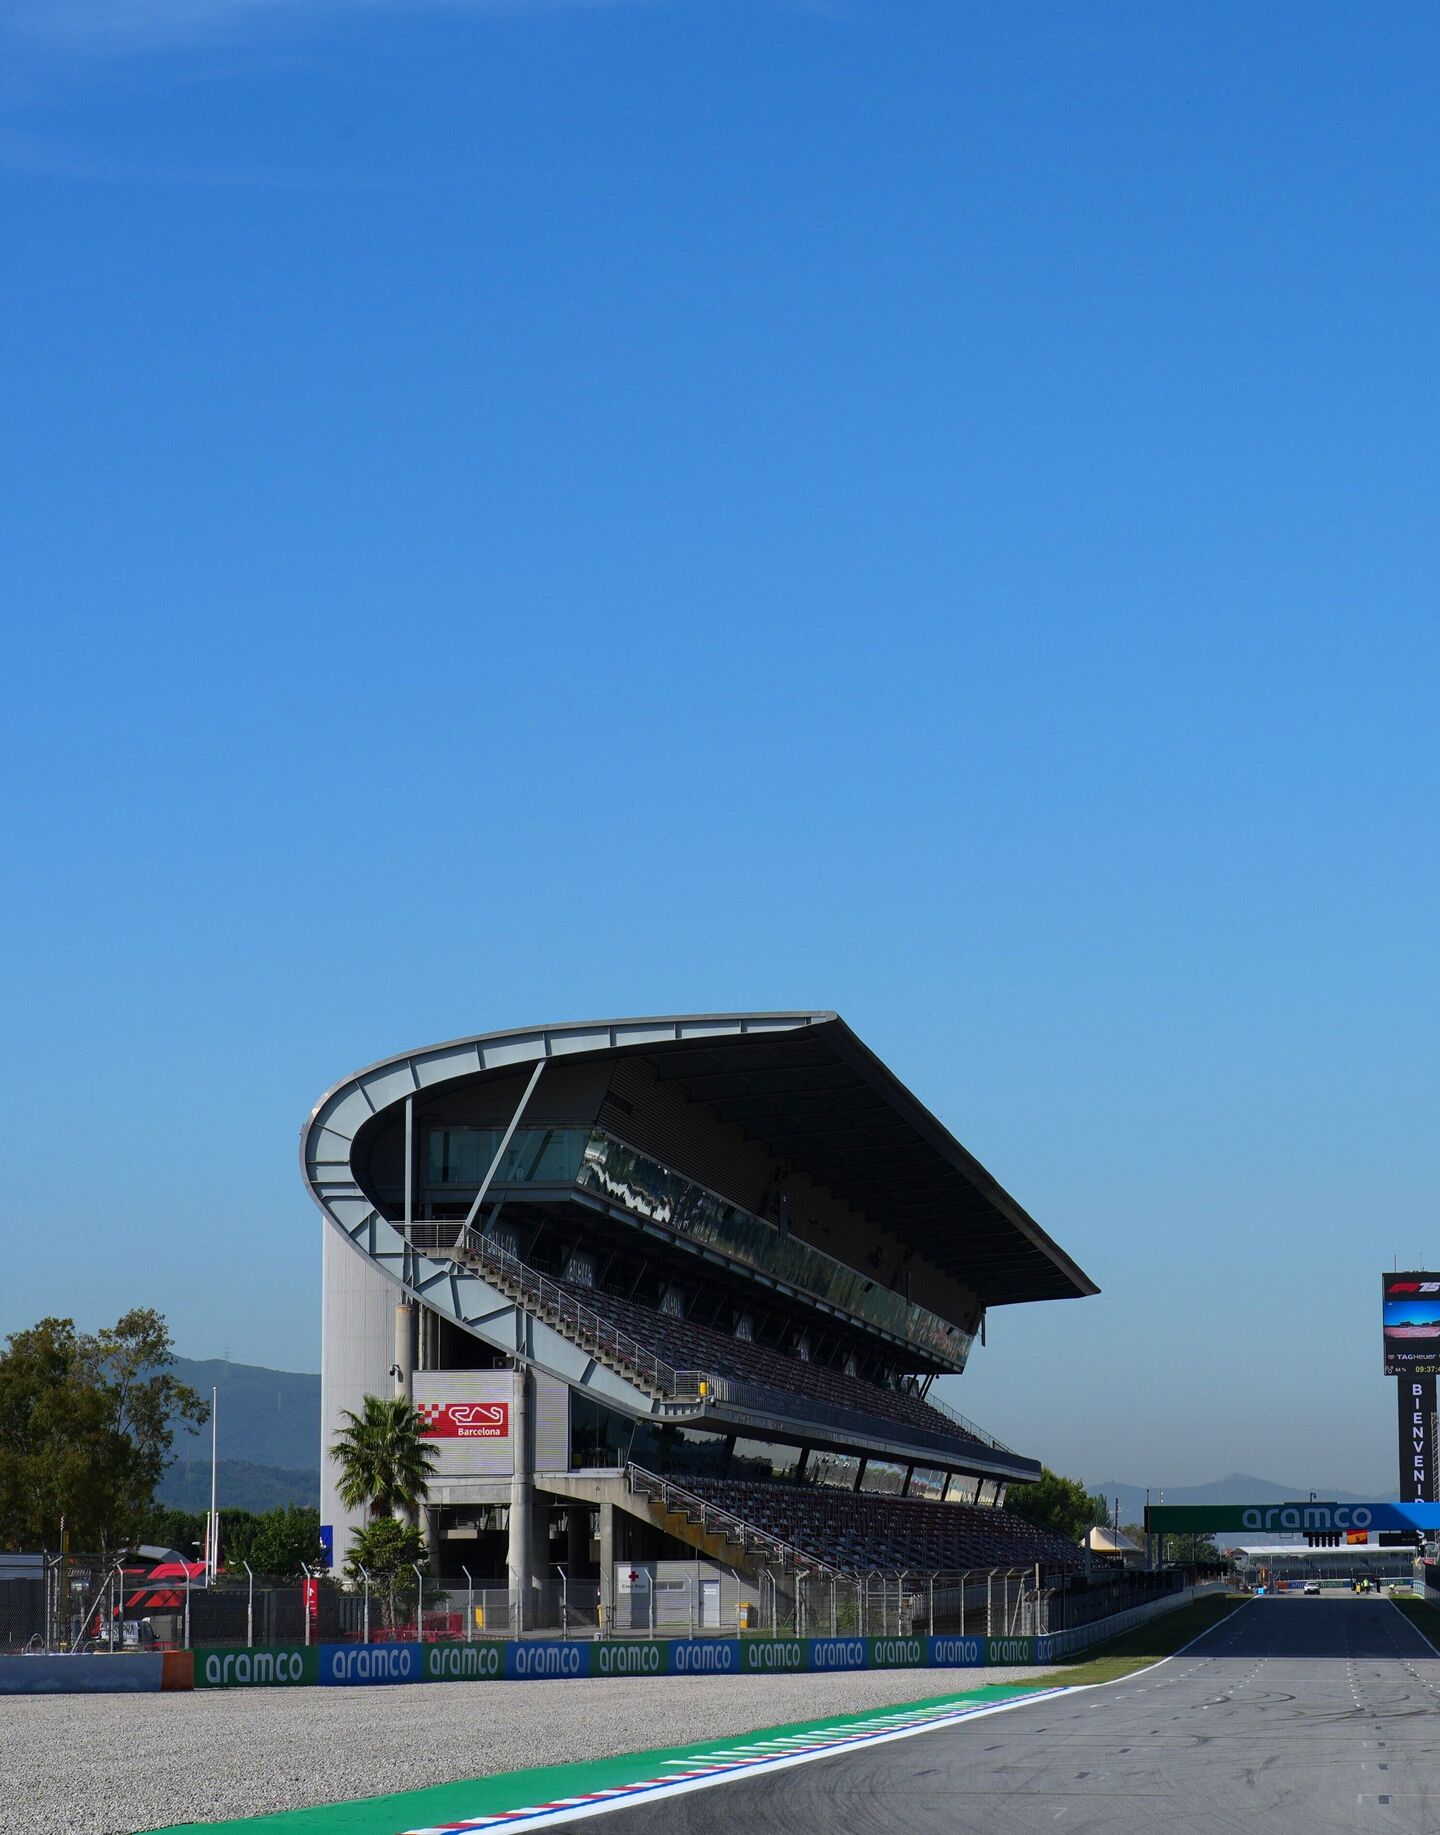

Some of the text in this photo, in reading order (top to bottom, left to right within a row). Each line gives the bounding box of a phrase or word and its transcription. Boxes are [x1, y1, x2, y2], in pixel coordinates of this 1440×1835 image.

[458, 1427, 500, 1436] Barcelona
[1242, 1507, 1373, 1530] aramco
[429, 1648, 498, 1675] aramco
[516, 1647, 580, 1673] aramco
[600, 1646, 659, 1671] aramco
[676, 1645, 731, 1669] aramco
[749, 1643, 801, 1667] aramco
[815, 1642, 863, 1665] aramco
[875, 1641, 920, 1663] aramco
[935, 1641, 978, 1662] aramco
[990, 1640, 1029, 1661] aramco
[205, 1653, 303, 1683] aramco
[332, 1649, 411, 1678] aramco
